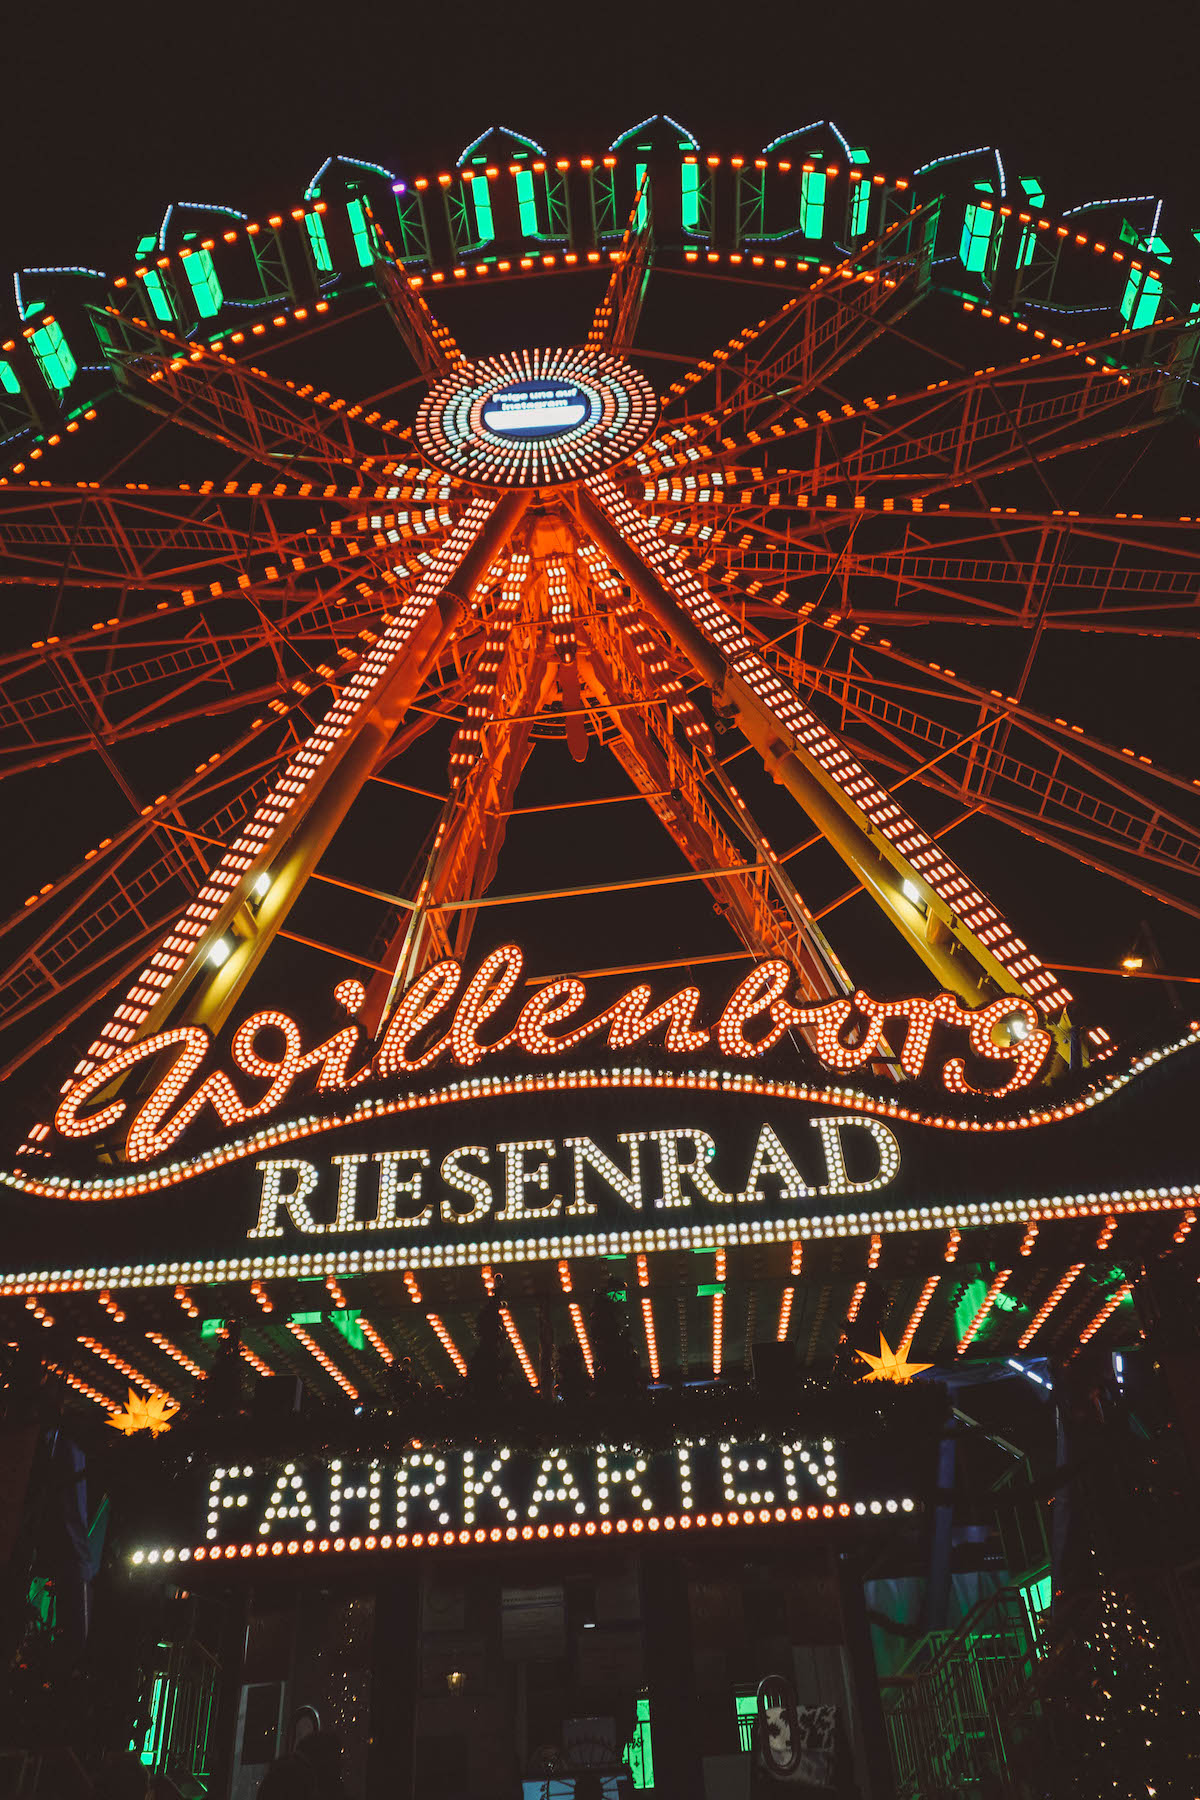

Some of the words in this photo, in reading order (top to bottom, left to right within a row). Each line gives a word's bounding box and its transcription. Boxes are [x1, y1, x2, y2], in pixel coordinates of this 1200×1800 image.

[501, 399, 568, 411] Instagram
[54, 944, 1052, 1162] Willenborg
[246, 1115, 901, 1238] RIESENRAD
[205, 1438, 838, 1540] FAHRKARTEN
